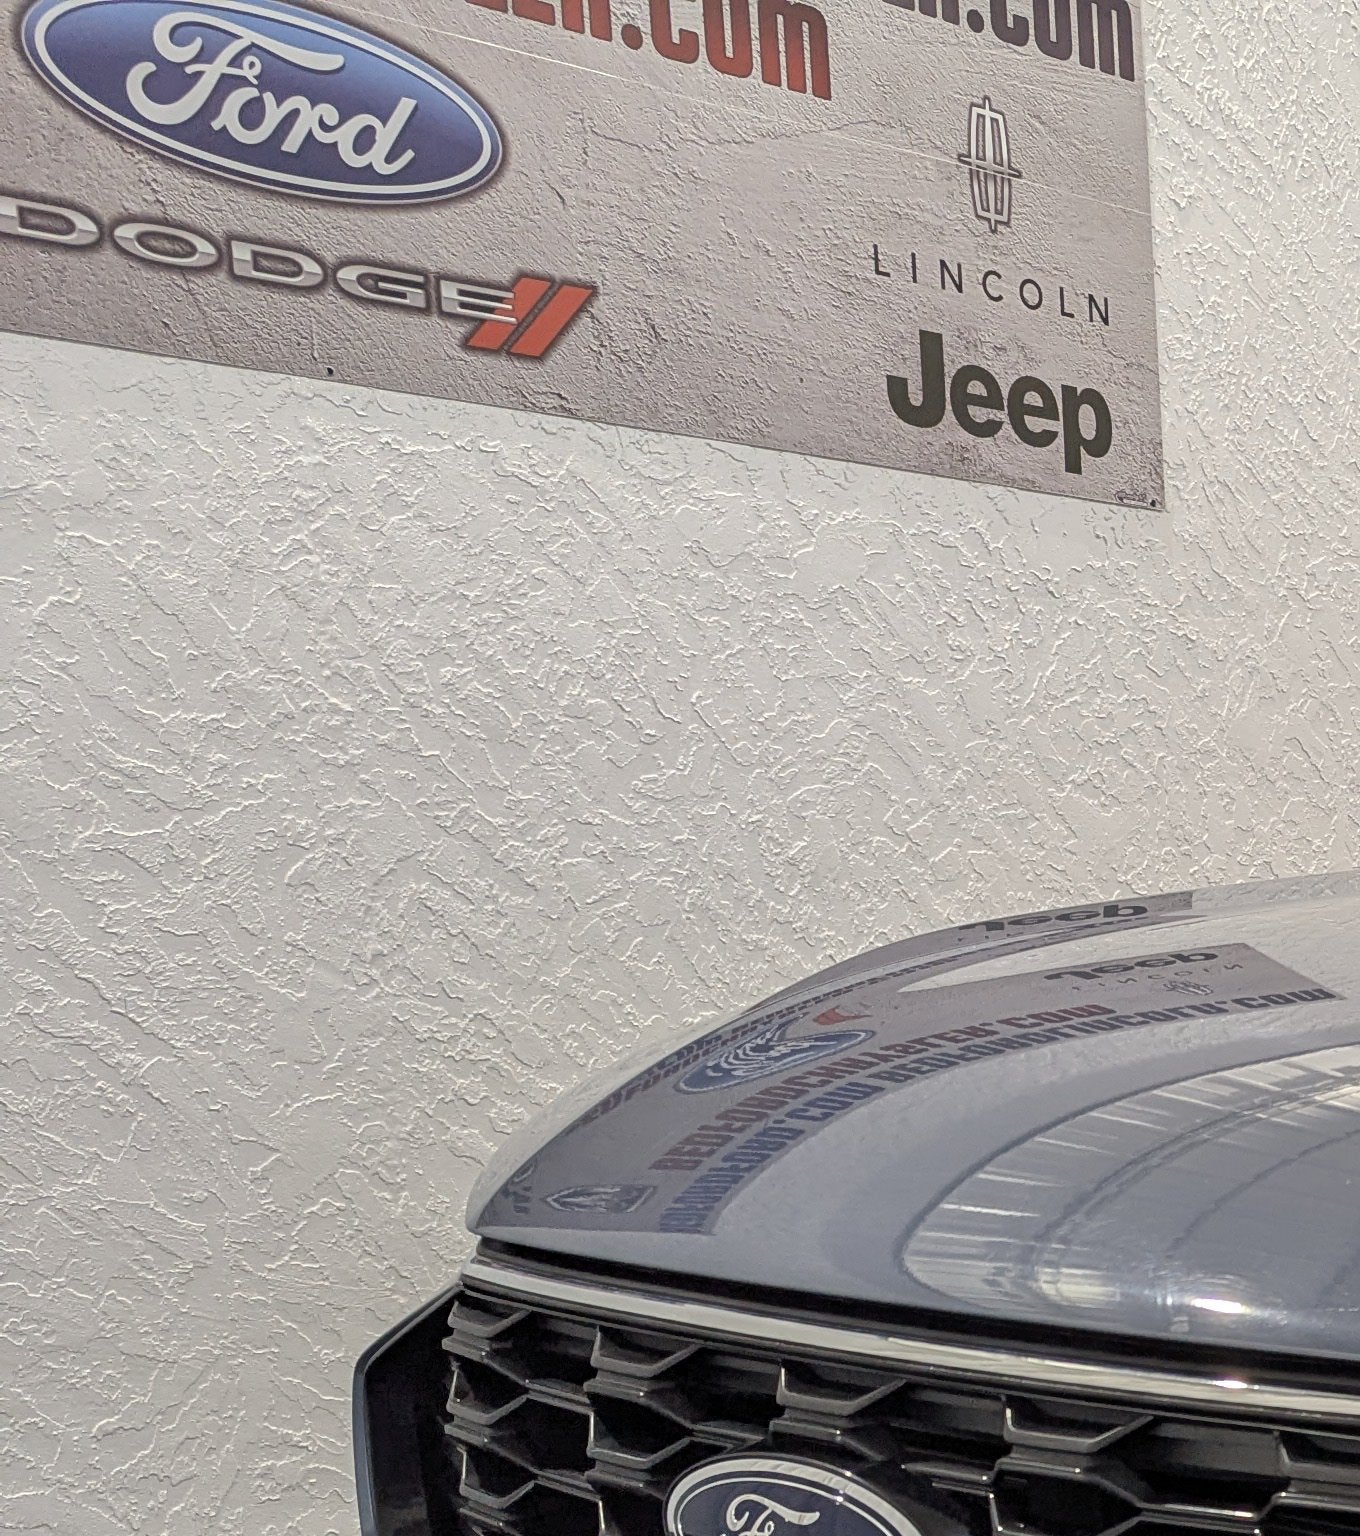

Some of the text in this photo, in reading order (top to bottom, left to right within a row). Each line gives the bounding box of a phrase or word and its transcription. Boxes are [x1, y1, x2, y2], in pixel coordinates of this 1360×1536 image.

[126, 12, 418, 176] Ford
[464, 0, 832, 101] .COM
[880, 0, 1136, 83] .COM
[0, 199, 518, 325] DODGE
[872, 243, 1110, 327] LINCOLN
[886, 328, 1113, 476] Jeep
